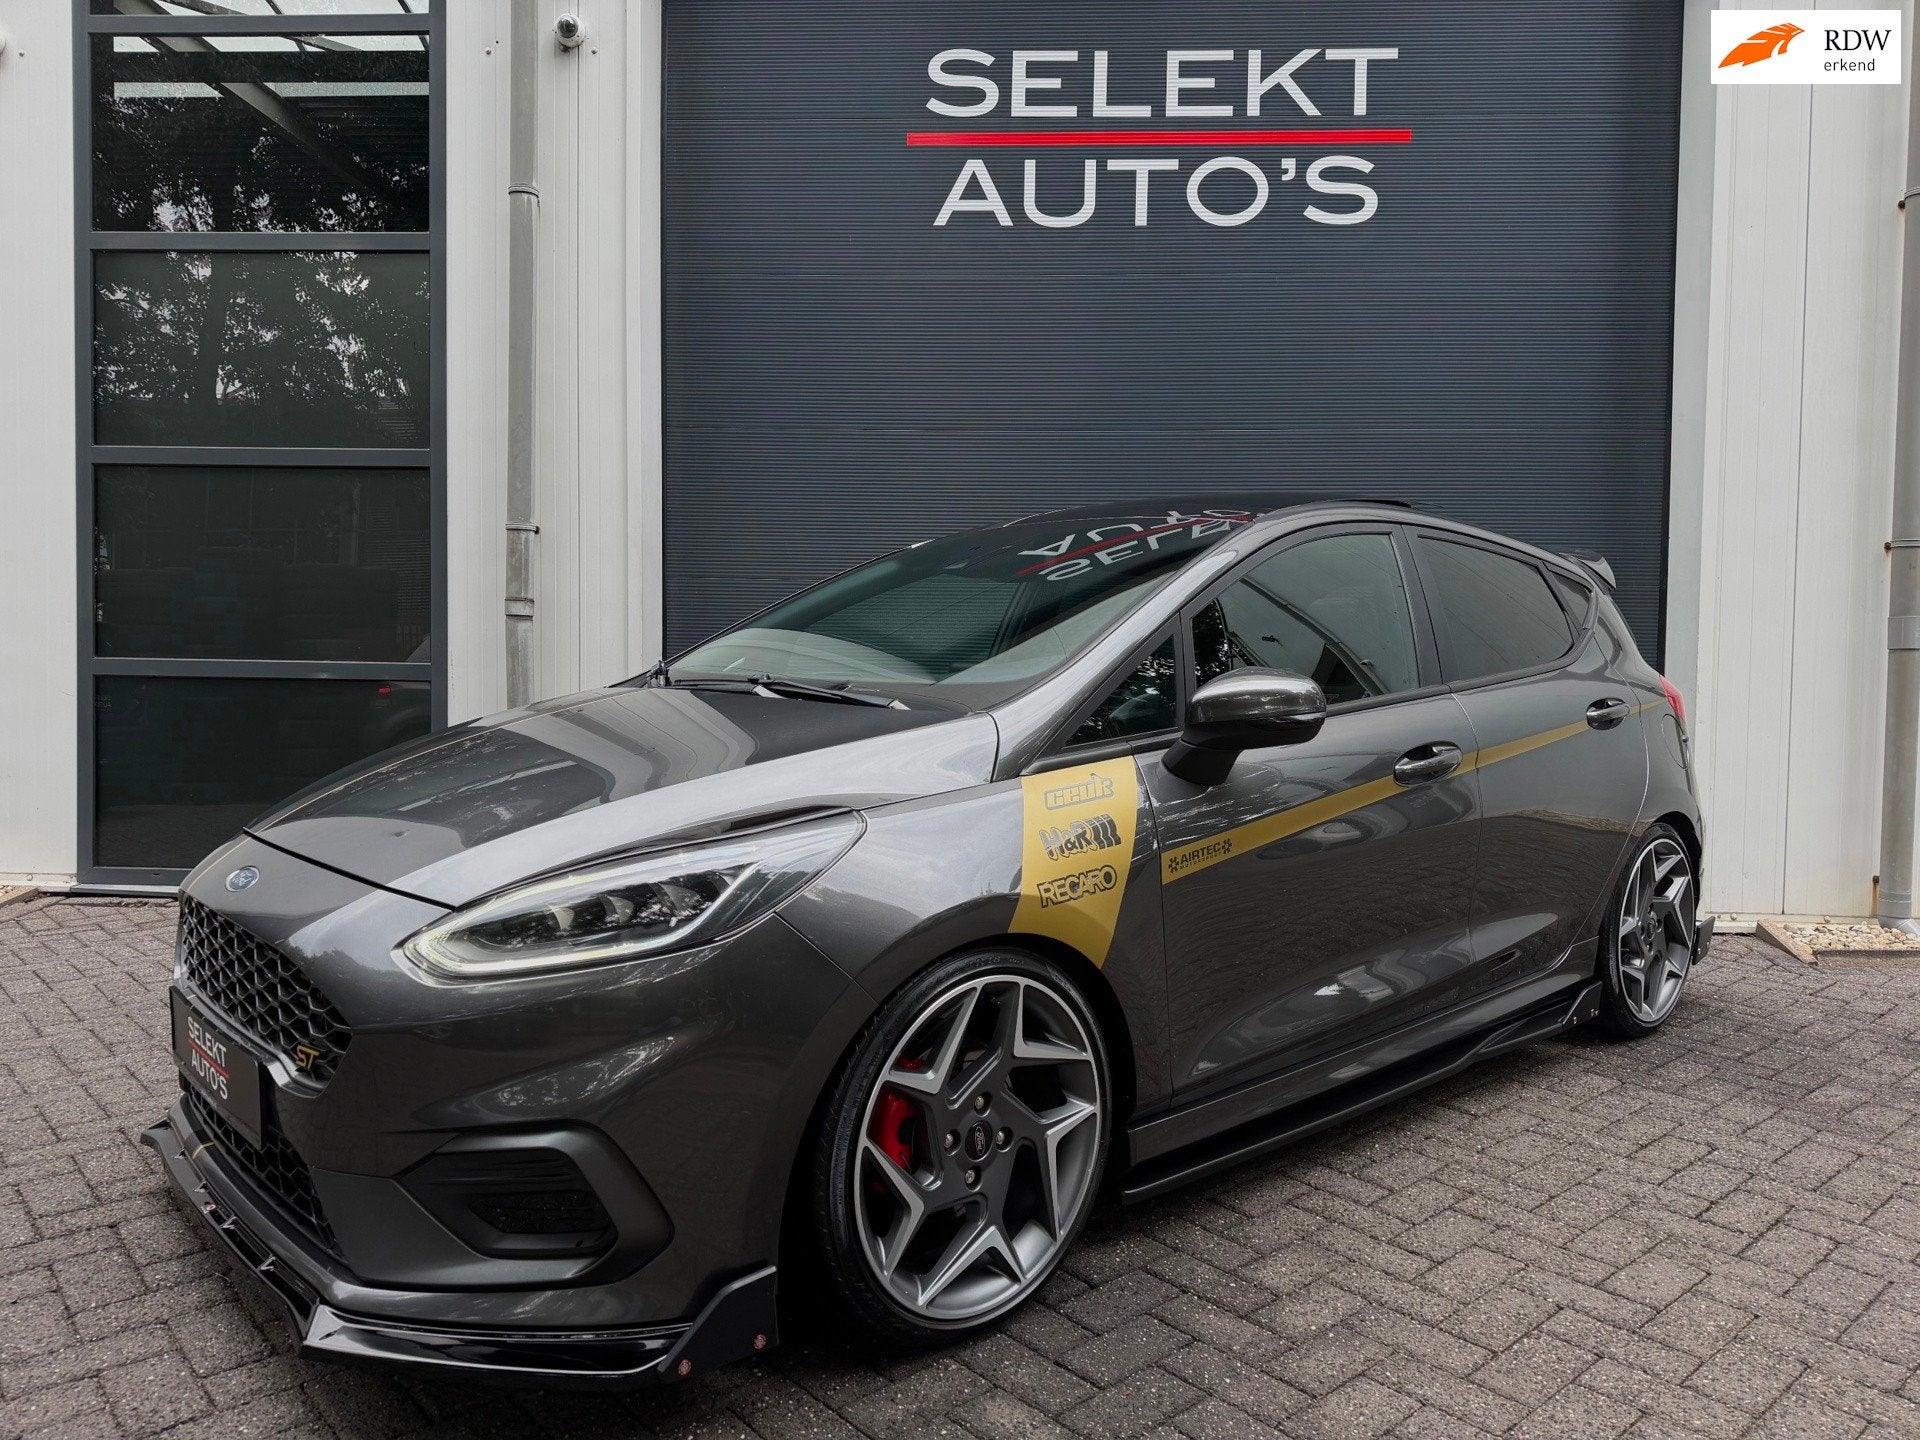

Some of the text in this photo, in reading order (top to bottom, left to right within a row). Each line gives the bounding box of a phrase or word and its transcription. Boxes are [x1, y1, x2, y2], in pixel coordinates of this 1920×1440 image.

[926, 48, 1399, 117] SELEKT
[933, 155, 1379, 228] AUTO'S
[1180, 842, 1221, 865] AIRTEC
[1037, 865, 1117, 908] RECARO
[187, 1016, 227, 1068] SELEKT
[296, 1044, 321, 1070] ST
[191, 1049, 228, 1100] AUTO'S
